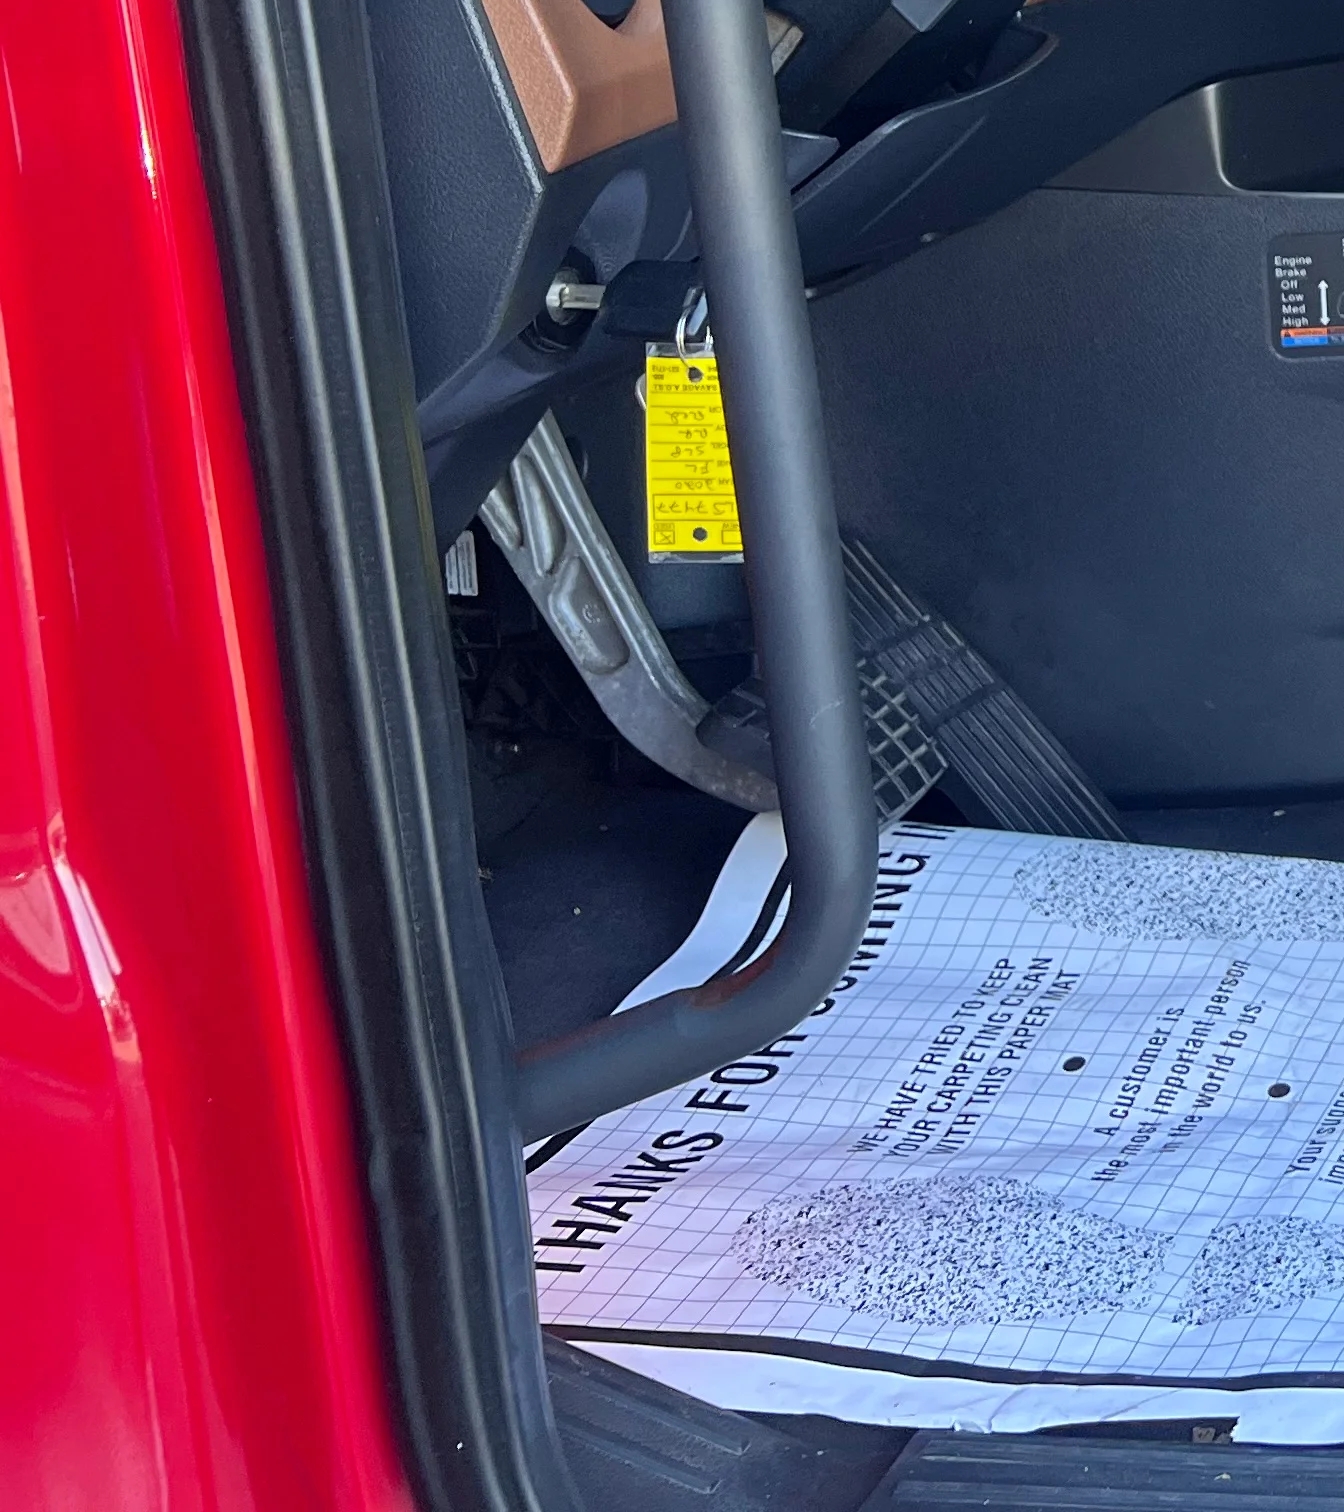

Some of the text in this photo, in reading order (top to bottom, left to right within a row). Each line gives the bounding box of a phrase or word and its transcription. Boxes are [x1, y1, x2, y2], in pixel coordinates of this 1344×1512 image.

[1274, 255, 1313, 267] Engine
[1275, 267, 1307, 278] Brake
[1280, 279, 1298, 289] Off
[1281, 292, 1305, 303] Low
[1282, 304, 1306, 315] Med
[1282, 316, 1309, 328] High
[847, 958, 1016, 1153] WE HAVE TRIED TO KEEP
[882, 957, 1053, 1157] YOUR CARPETING CLEAN
[926, 970, 1081, 1155] WITH THIS PAPER MAT
[1091, 959, 1251, 1182] the most important person
[1094, 1007, 1184, 1137] A customer is
[1168, 1114, 1203, 1137] the
[1193, 1053, 1236, 1109] world
[1220, 1030, 1248, 1048] to
[1238, 1000, 1266, 1024] us.
[1285, 1139, 1327, 1175] Your
[534, 1129, 724, 1274] THANKS
